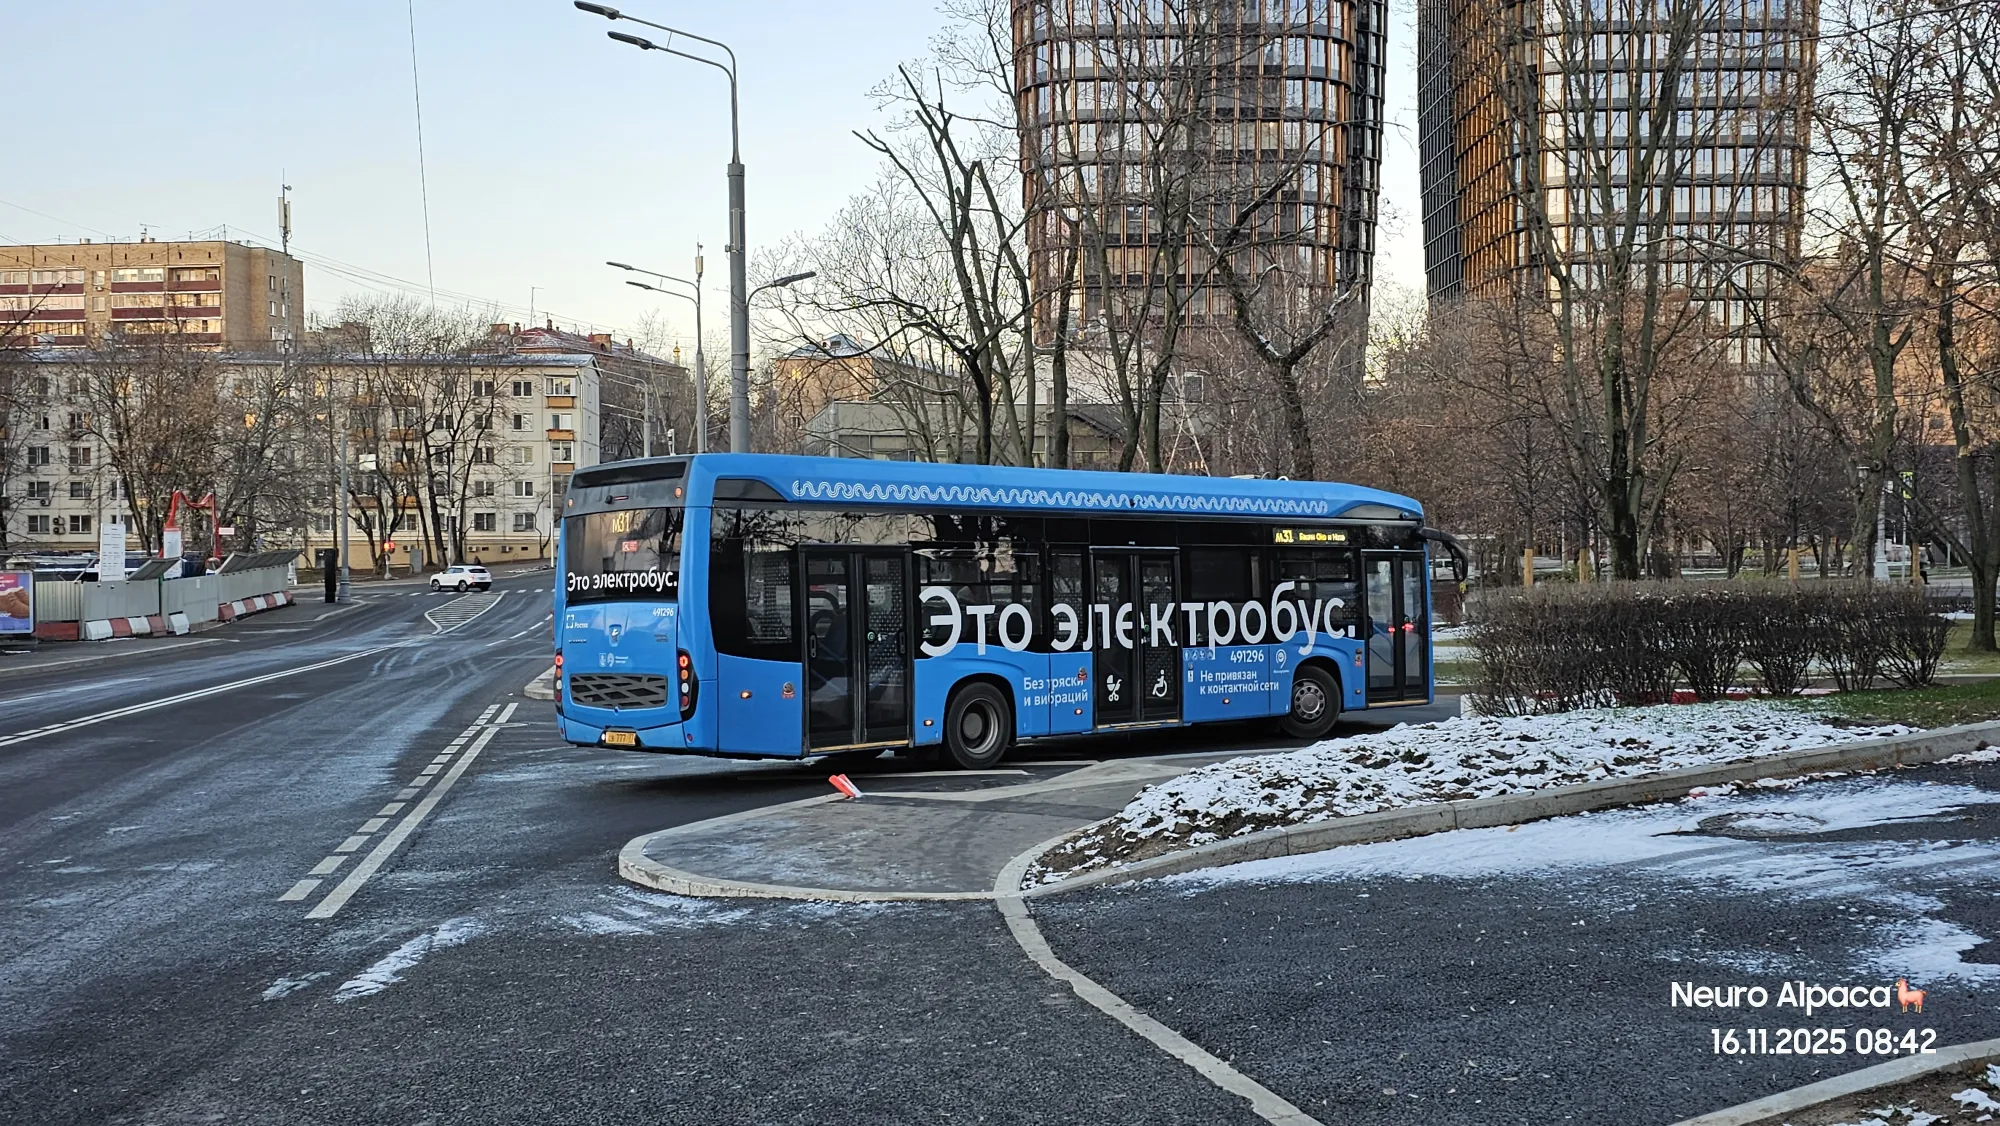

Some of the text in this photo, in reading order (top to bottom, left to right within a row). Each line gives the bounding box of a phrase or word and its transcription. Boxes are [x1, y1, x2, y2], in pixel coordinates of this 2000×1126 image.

[567, 566, 678, 592] Это электробус.
[652, 607, 675, 617] 491296
[919, 581, 1355, 659] Это электробус.
[1230, 649, 1265, 663] 491296
[1023, 677, 1045, 691] Без
[1200, 670, 1257, 684] Не привязан
[1200, 680, 1279, 695] к контактной сети
[1024, 689, 1088, 707] и вибраций
